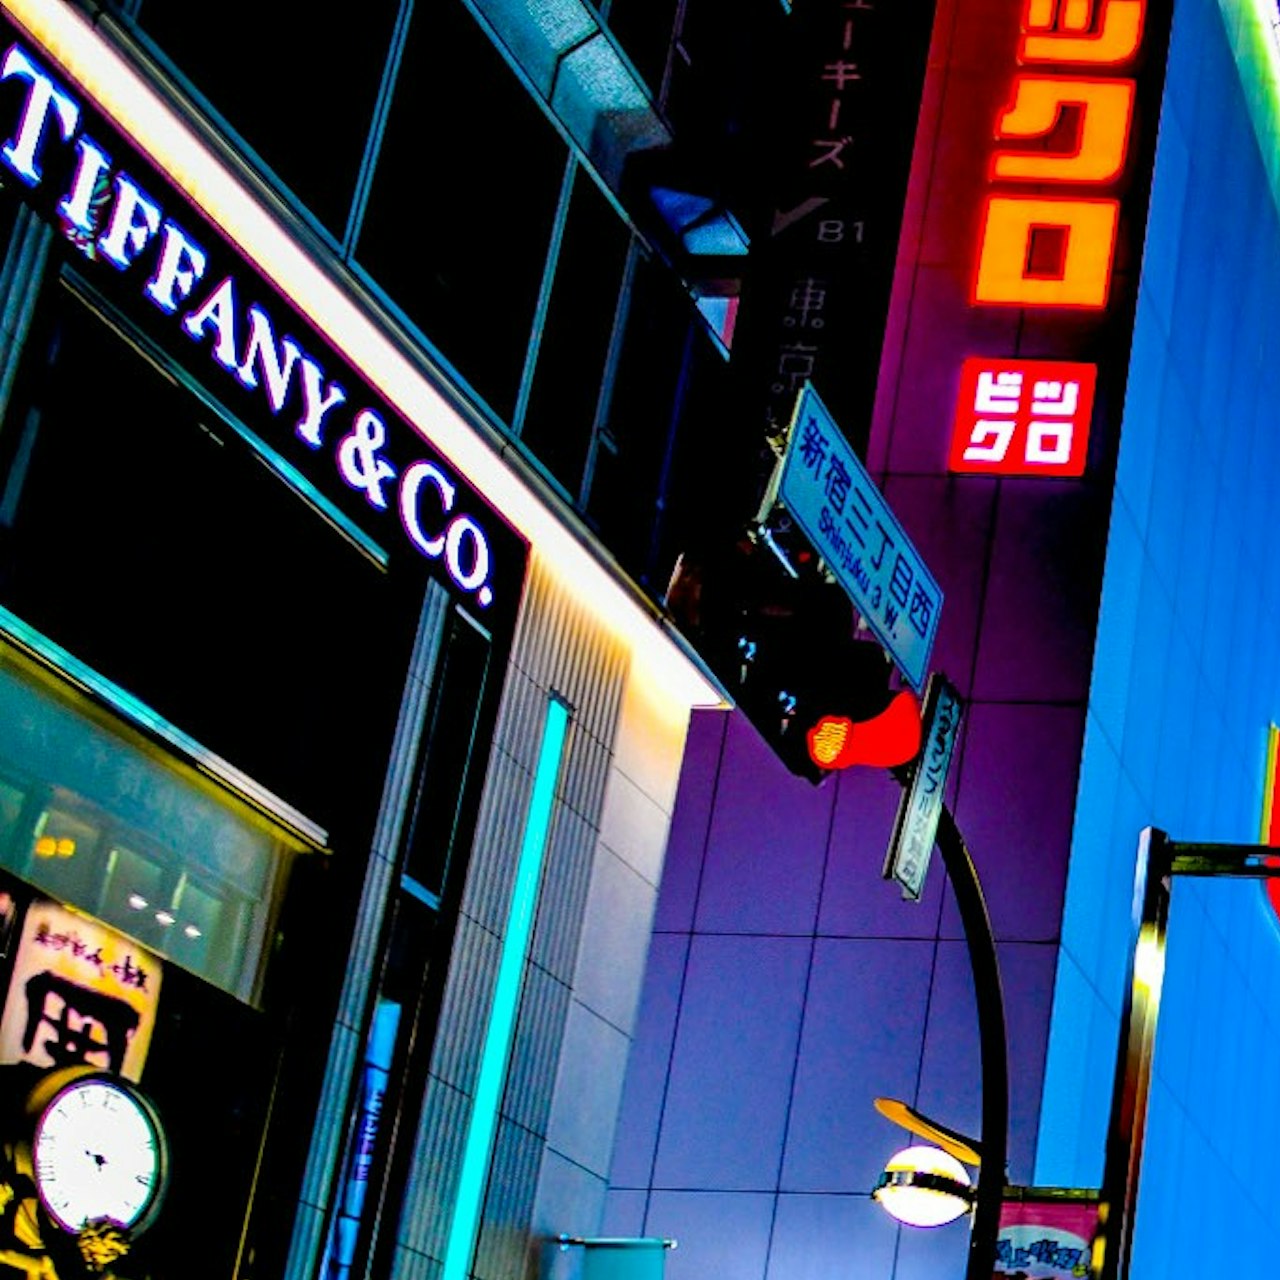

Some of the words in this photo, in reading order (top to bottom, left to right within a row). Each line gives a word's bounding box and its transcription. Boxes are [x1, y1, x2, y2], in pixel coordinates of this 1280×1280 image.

[816, 219, 865, 243] B1
[798, 416, 937, 640] 新宿三丁目西
[817, 505, 872, 598] Shinjuku
